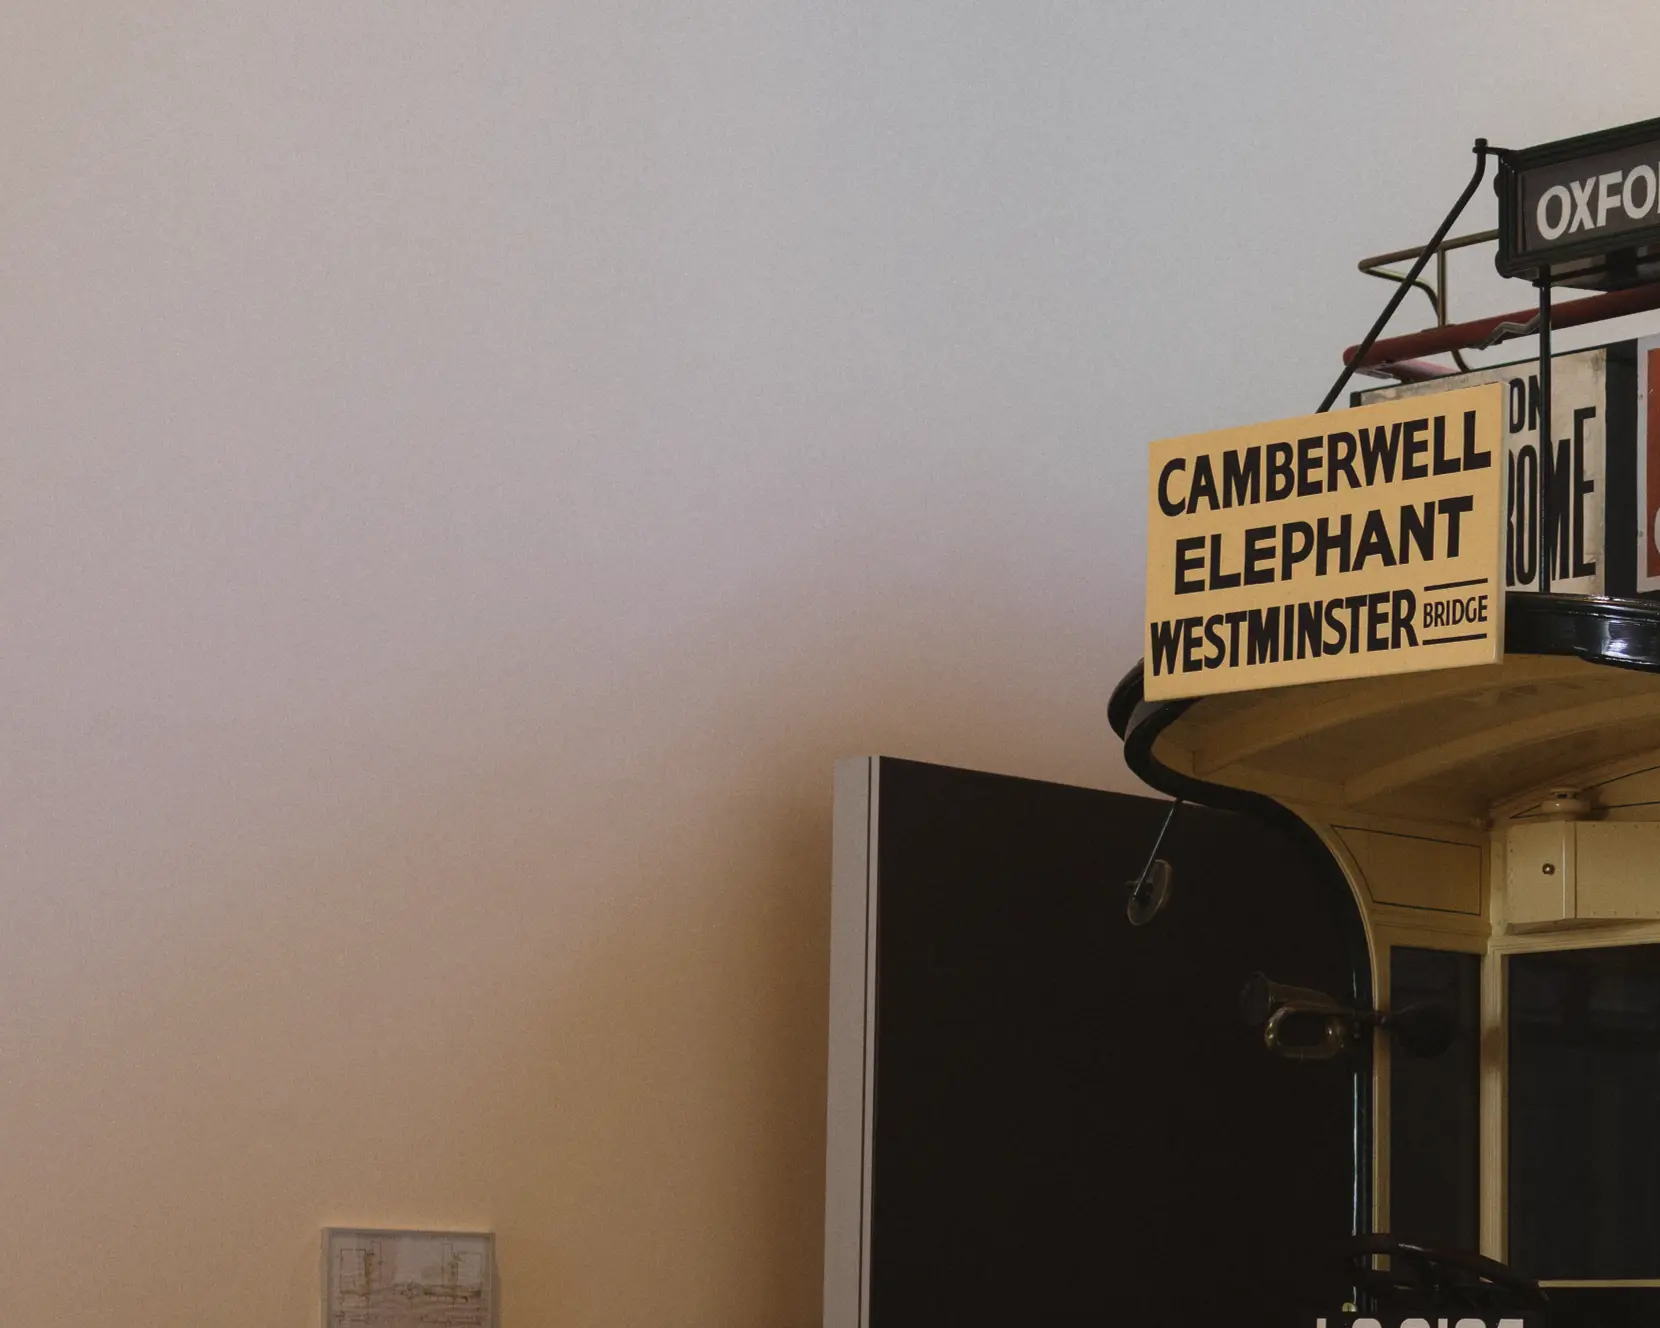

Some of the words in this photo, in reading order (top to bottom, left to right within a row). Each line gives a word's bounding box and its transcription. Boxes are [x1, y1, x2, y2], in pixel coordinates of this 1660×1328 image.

[1157, 410, 1491, 518] CAMBERWELL
[1174, 495, 1474, 595] ELEPHANT
[1150, 588, 1419, 678] WESTMINSTER
[1422, 594, 1488, 629] BRIDGE
